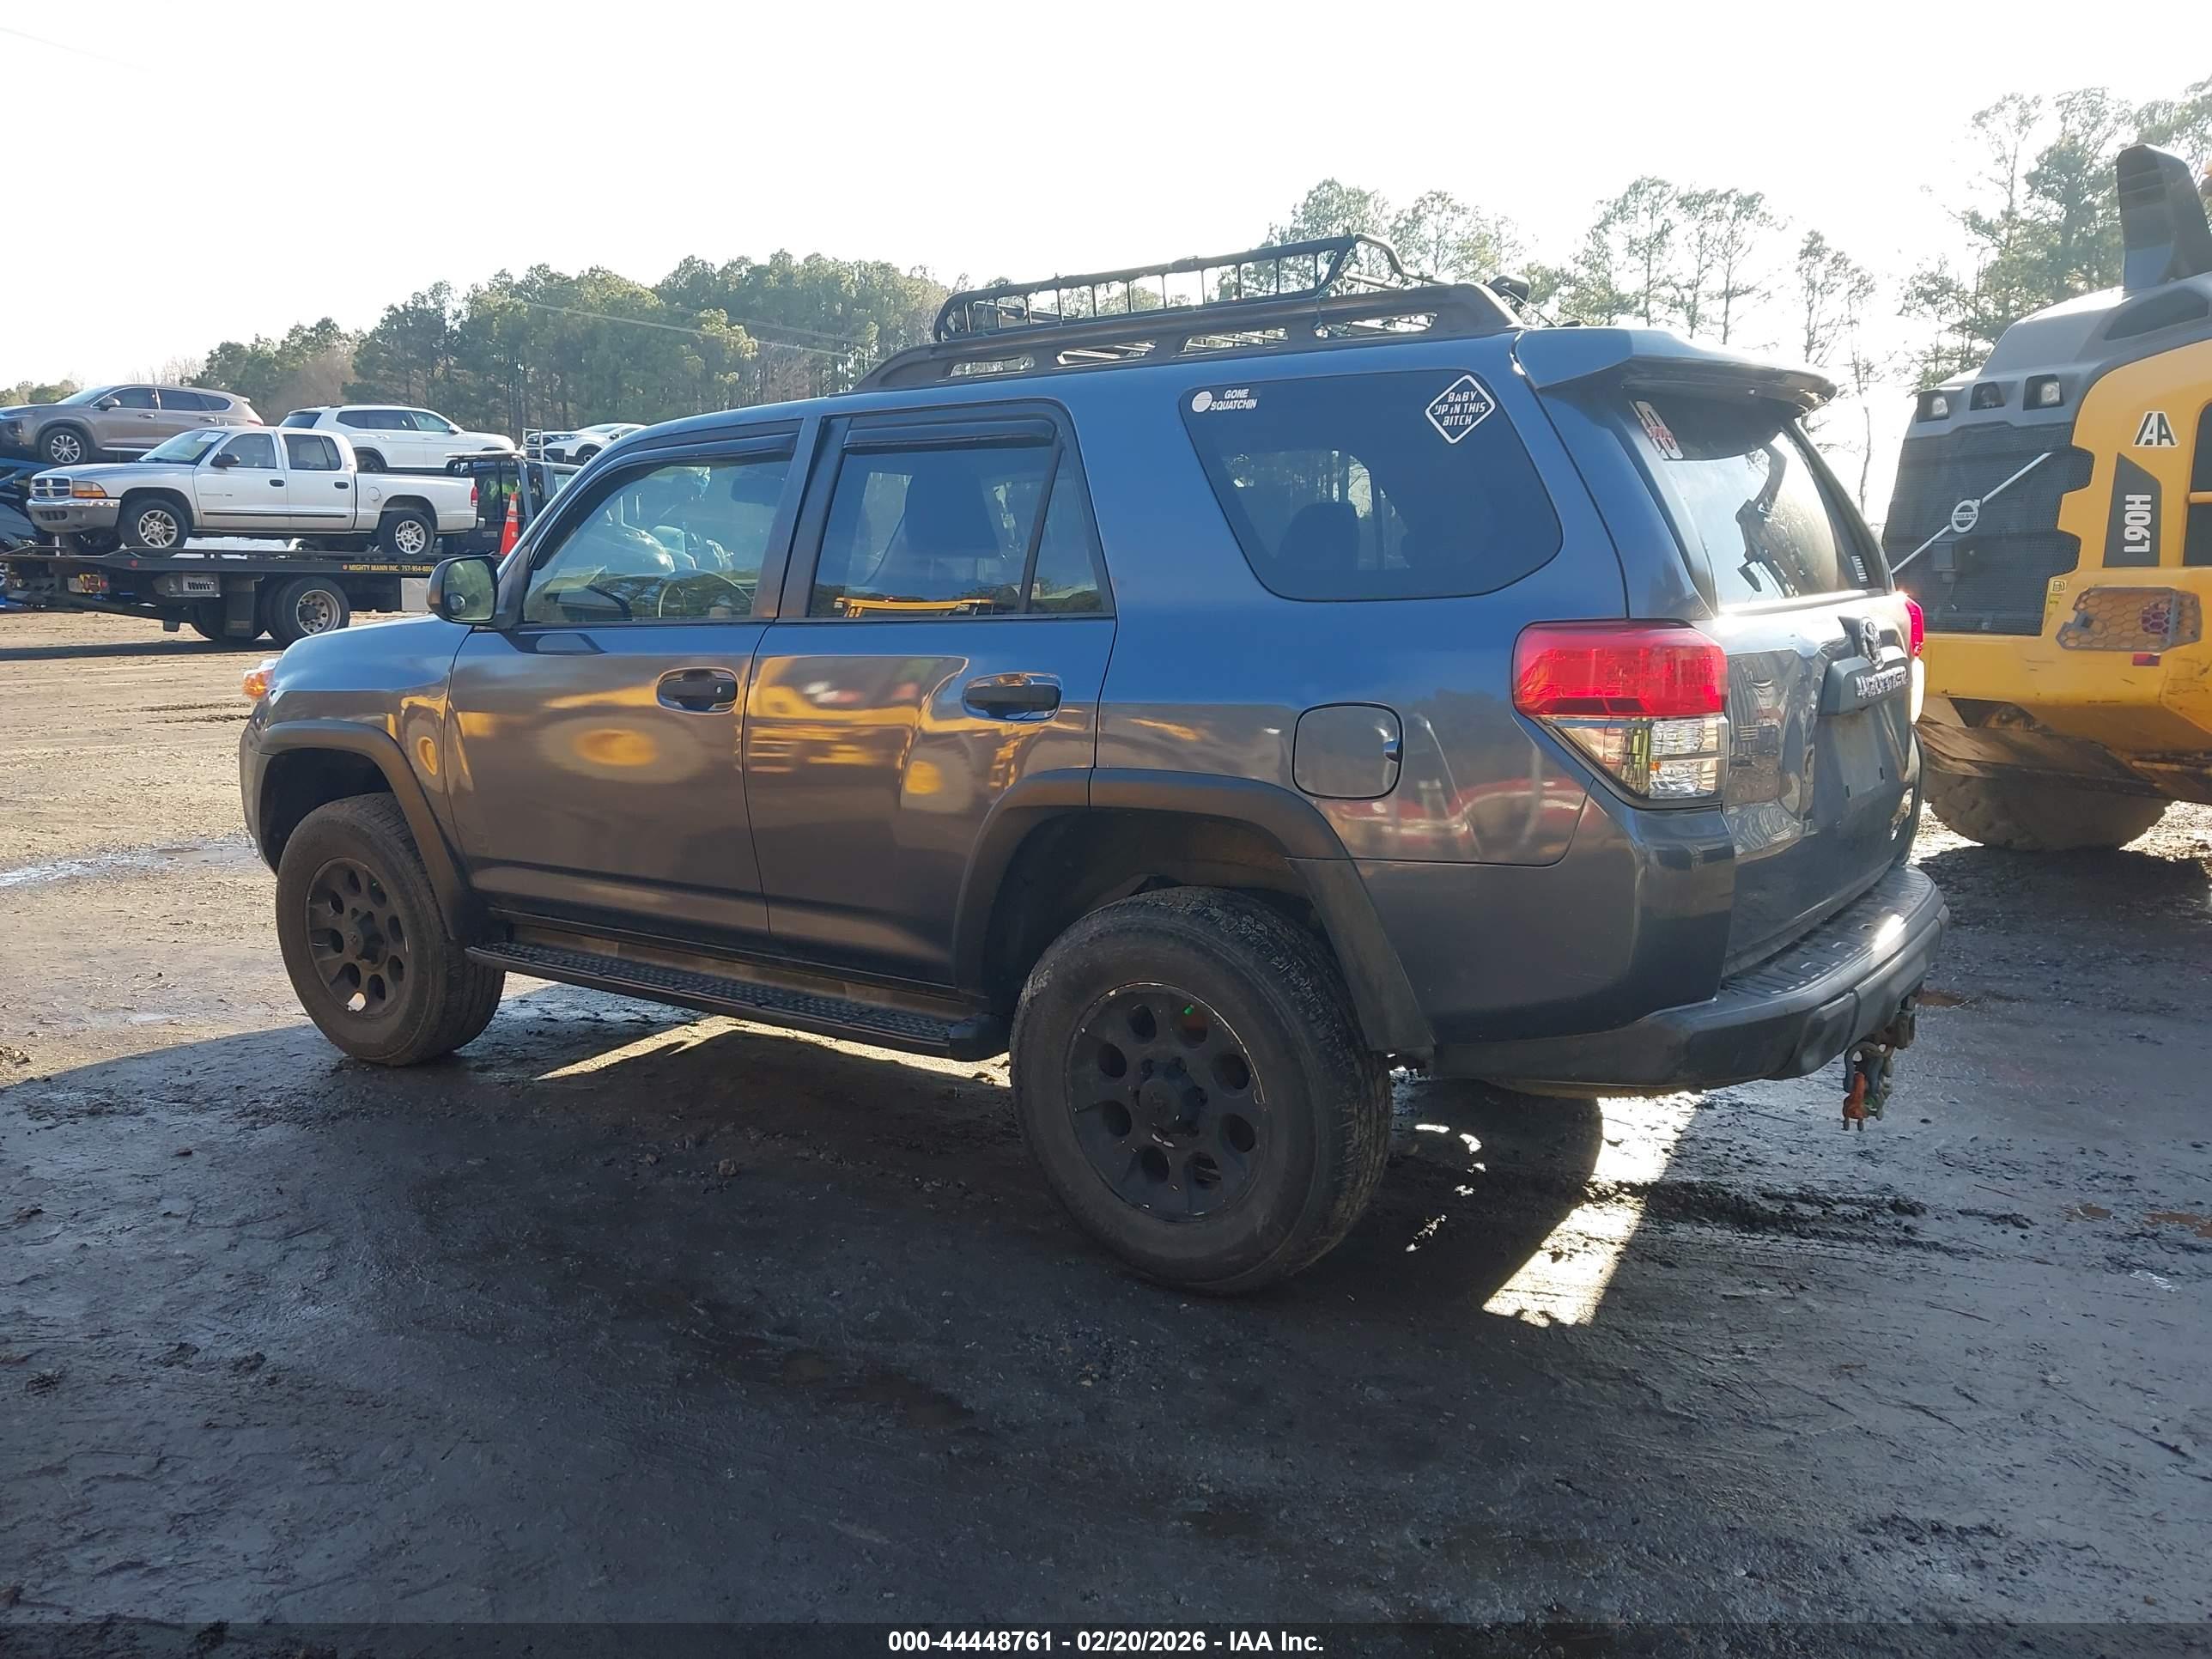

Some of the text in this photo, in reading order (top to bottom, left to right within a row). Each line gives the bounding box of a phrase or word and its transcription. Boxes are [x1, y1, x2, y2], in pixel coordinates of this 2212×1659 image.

[1224, 388, 1249, 399] GONE
[1448, 391, 1477, 403] BABY
[1210, 398, 1258, 410] SQUATCHIN
[1434, 404, 1449, 415] UP
[1463, 402, 1486, 413] THIS
[1443, 415, 1473, 426] BITCH
[2124, 494, 2152, 552] L90H
